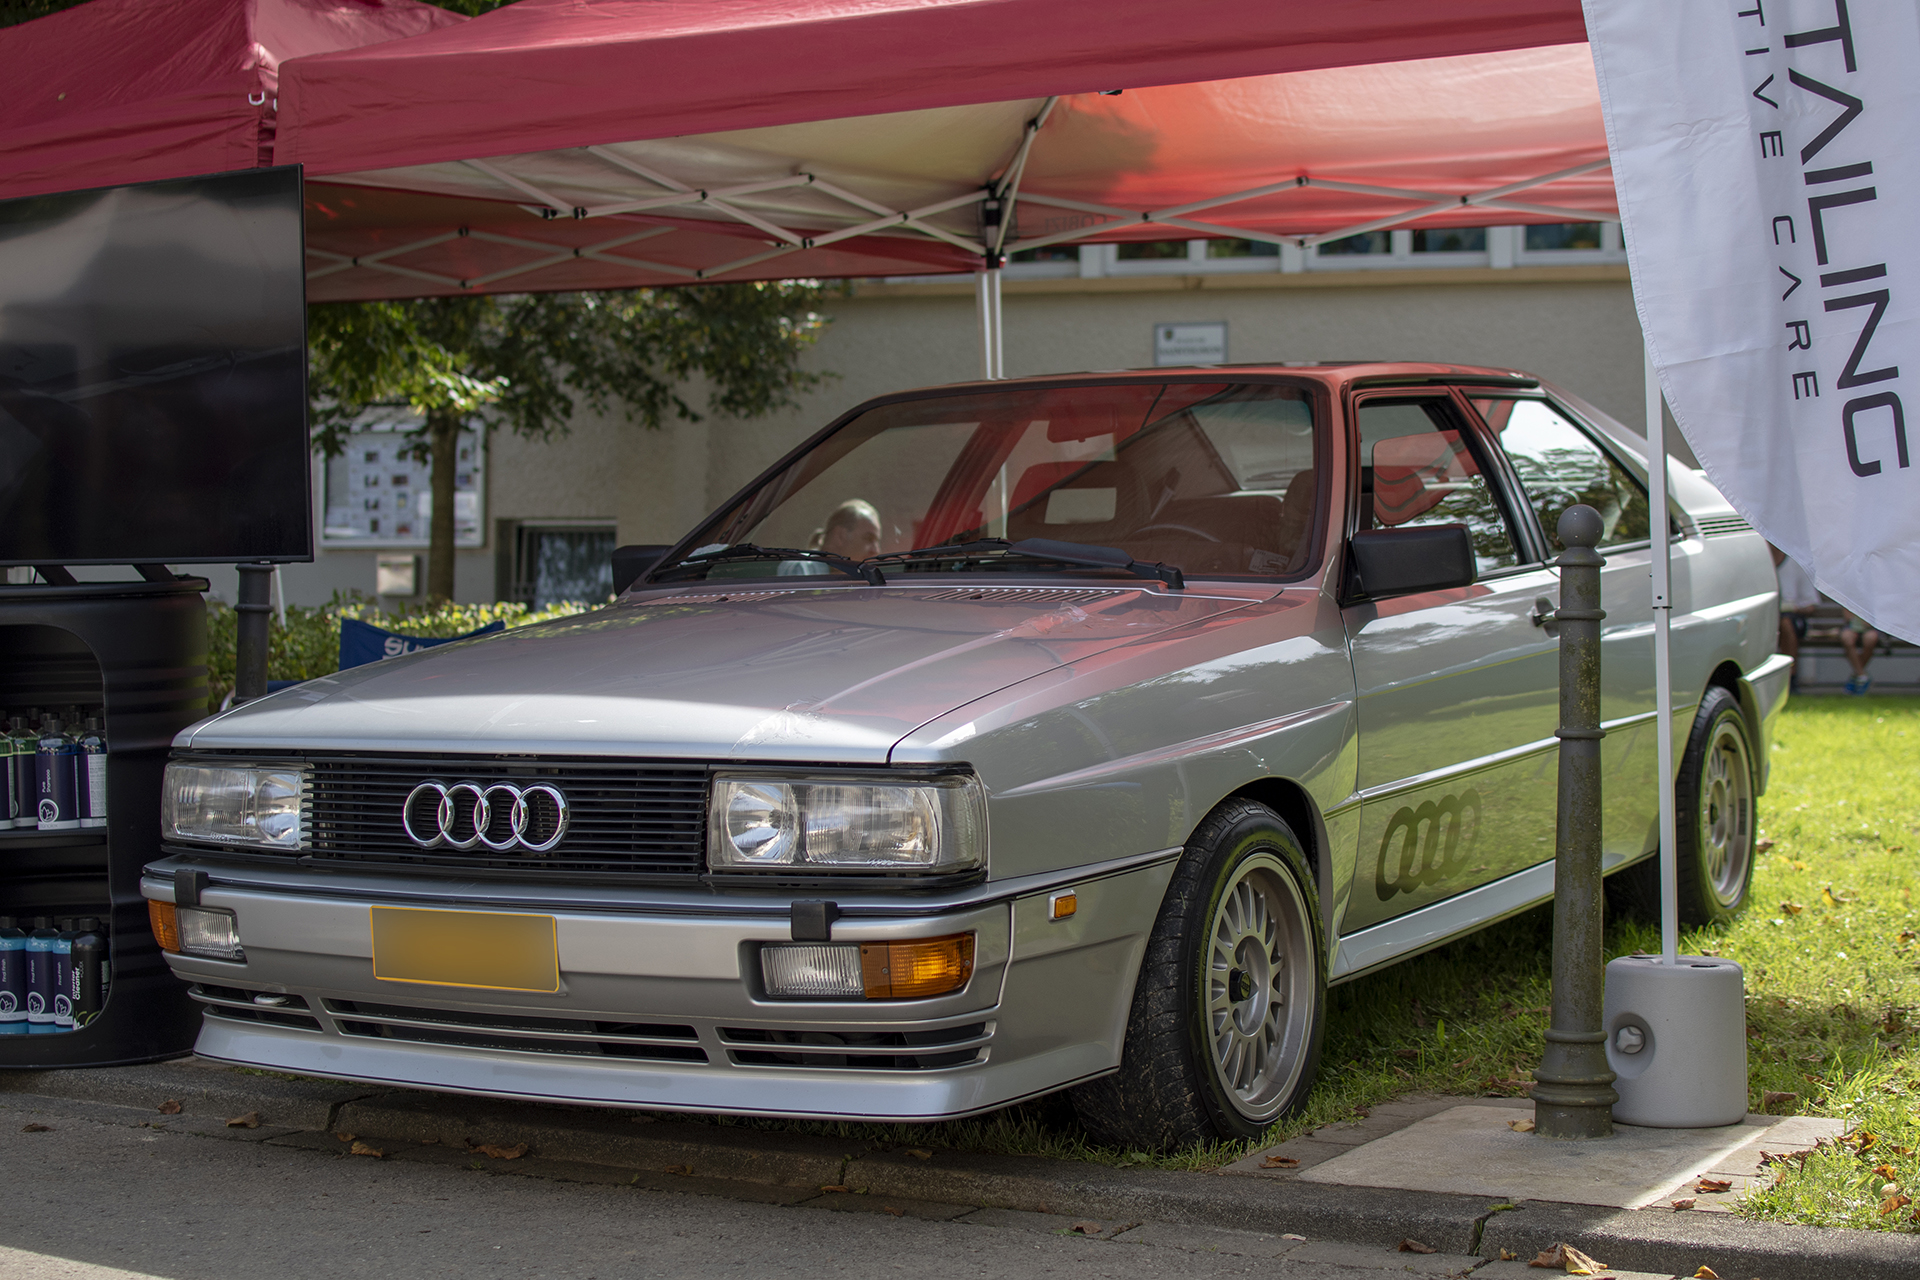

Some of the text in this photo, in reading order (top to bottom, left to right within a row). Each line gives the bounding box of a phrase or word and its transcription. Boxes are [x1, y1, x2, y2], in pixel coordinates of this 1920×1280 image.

[1737, 0, 1820, 400] TIVE CARE
[1784, 0, 1910, 478] TAILING
